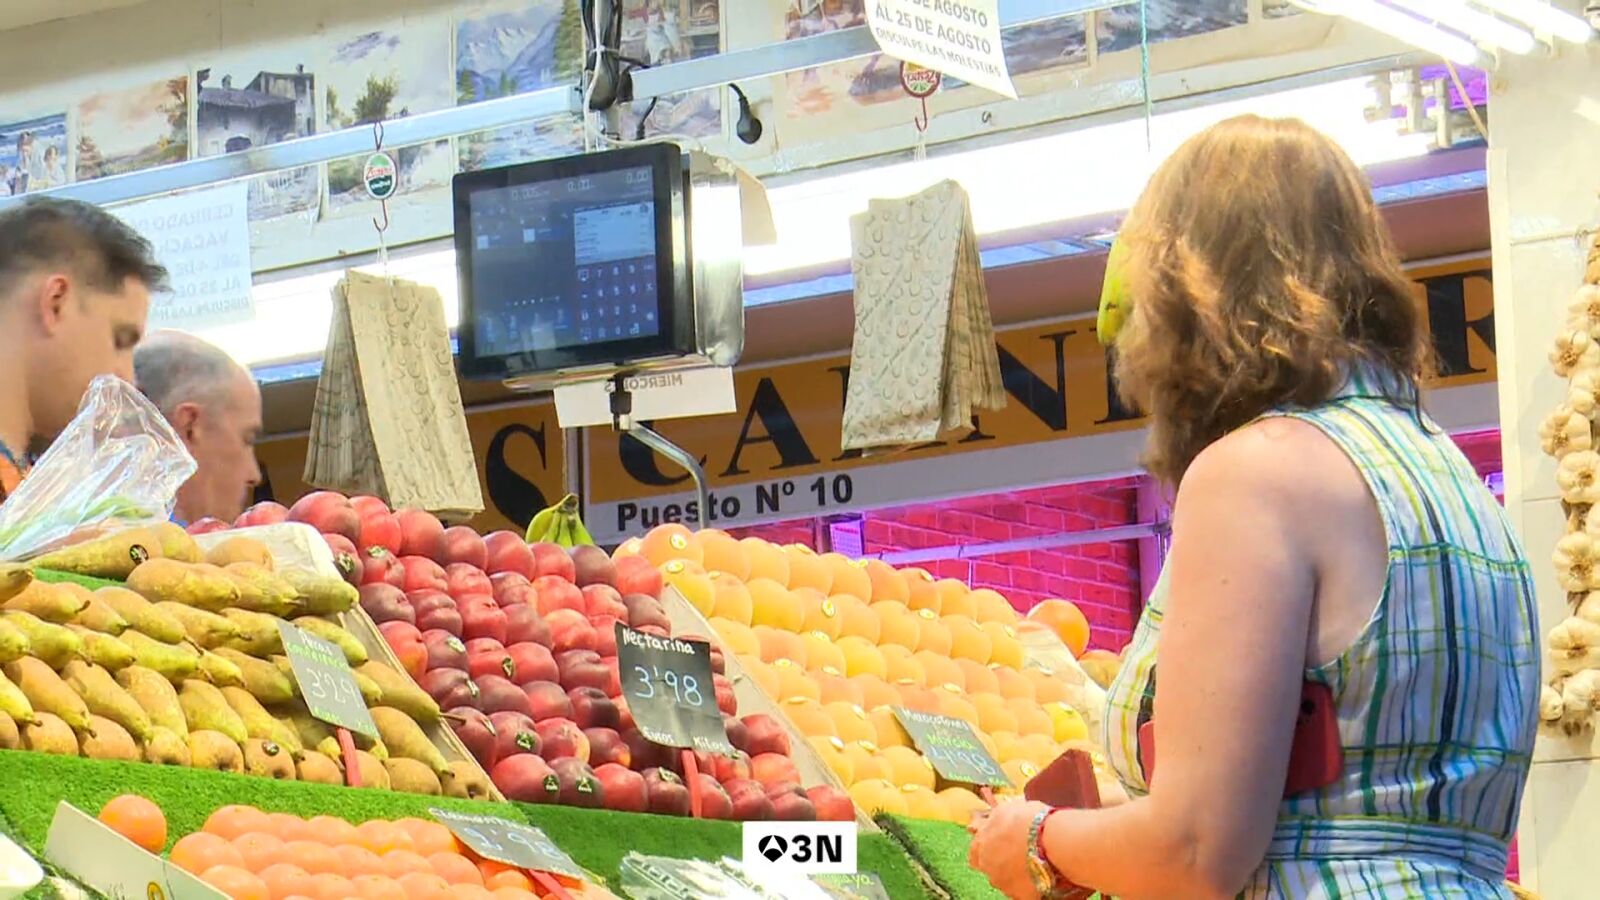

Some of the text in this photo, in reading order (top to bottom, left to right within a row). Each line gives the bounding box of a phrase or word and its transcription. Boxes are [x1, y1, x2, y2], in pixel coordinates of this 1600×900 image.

[876, 3, 992, 54] AL 25 DE AGOSTO
[935, 0, 988, 28] AGOSTO
[876, 27, 1001, 77] DISCULPE LAS MOLESTIAS
[618, 492, 741, 532] Puesto
[810, 473, 853, 507] 10
[622, 627, 695, 655] Nectarina
[634, 665, 702, 706] 3'98
